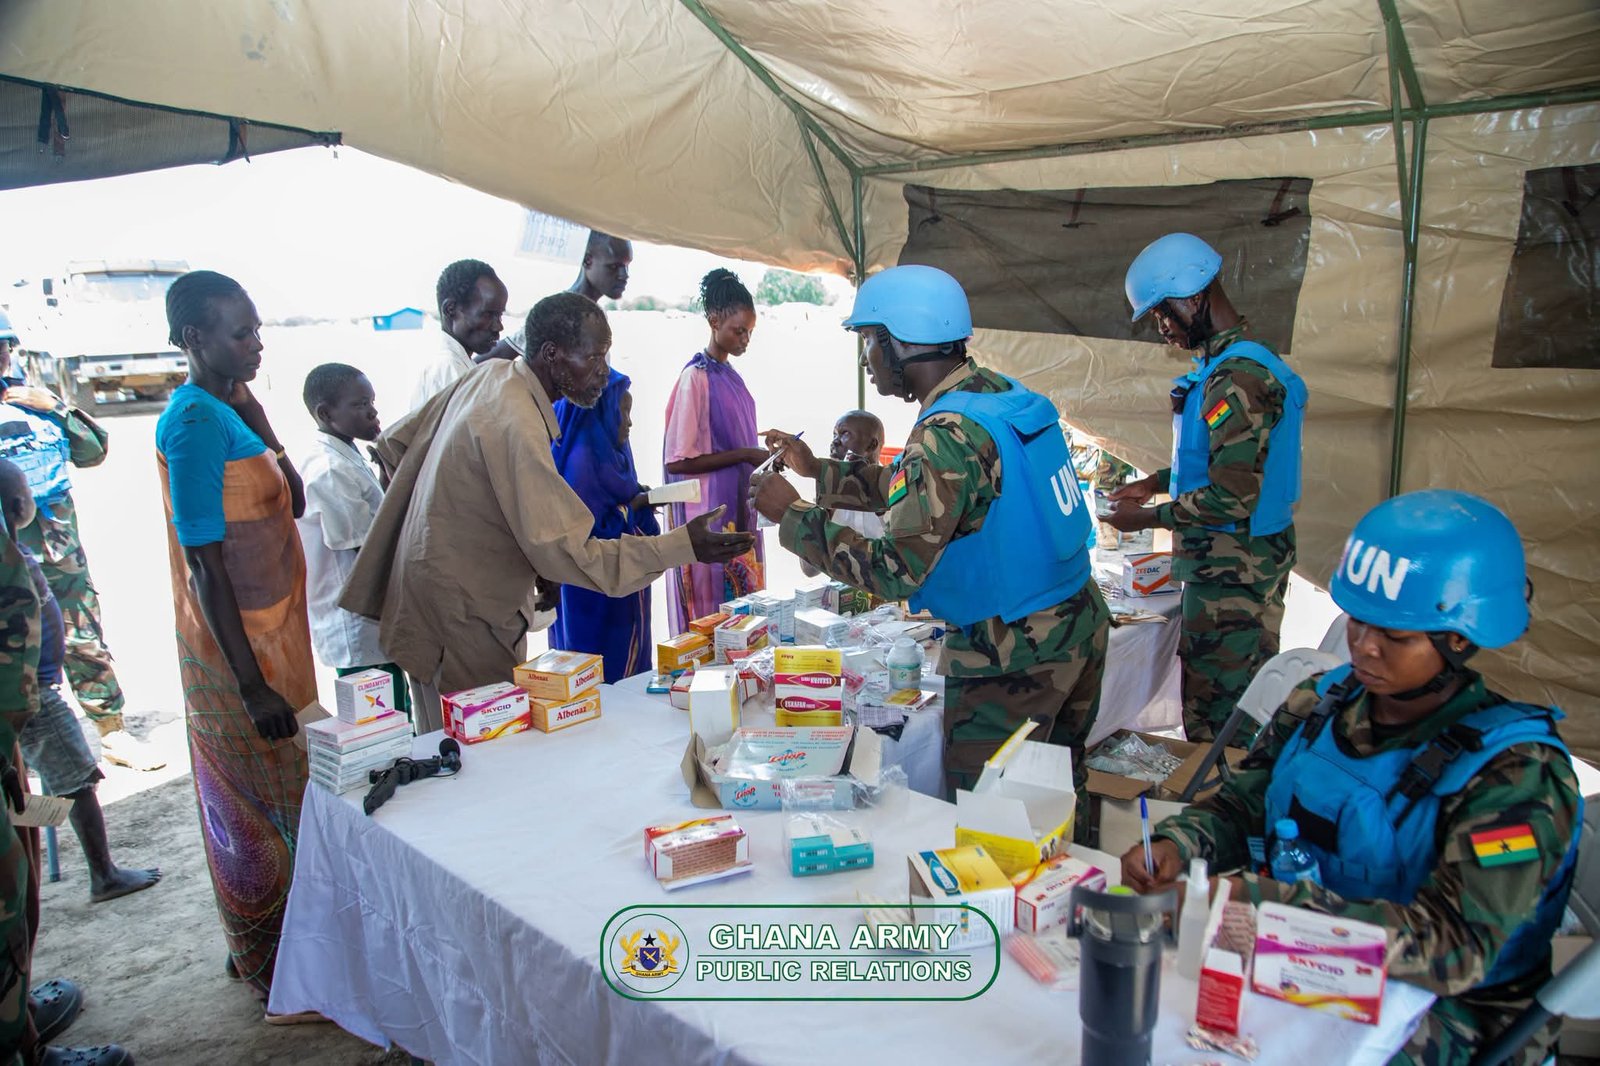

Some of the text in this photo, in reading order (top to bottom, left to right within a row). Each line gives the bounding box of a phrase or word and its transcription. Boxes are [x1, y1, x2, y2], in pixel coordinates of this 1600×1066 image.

[1050, 459, 1082, 517] UN
[1347, 539, 1411, 601] UN
[480, 703, 512, 716] SKYCID
[1287, 952, 1345, 976] SKYCID
